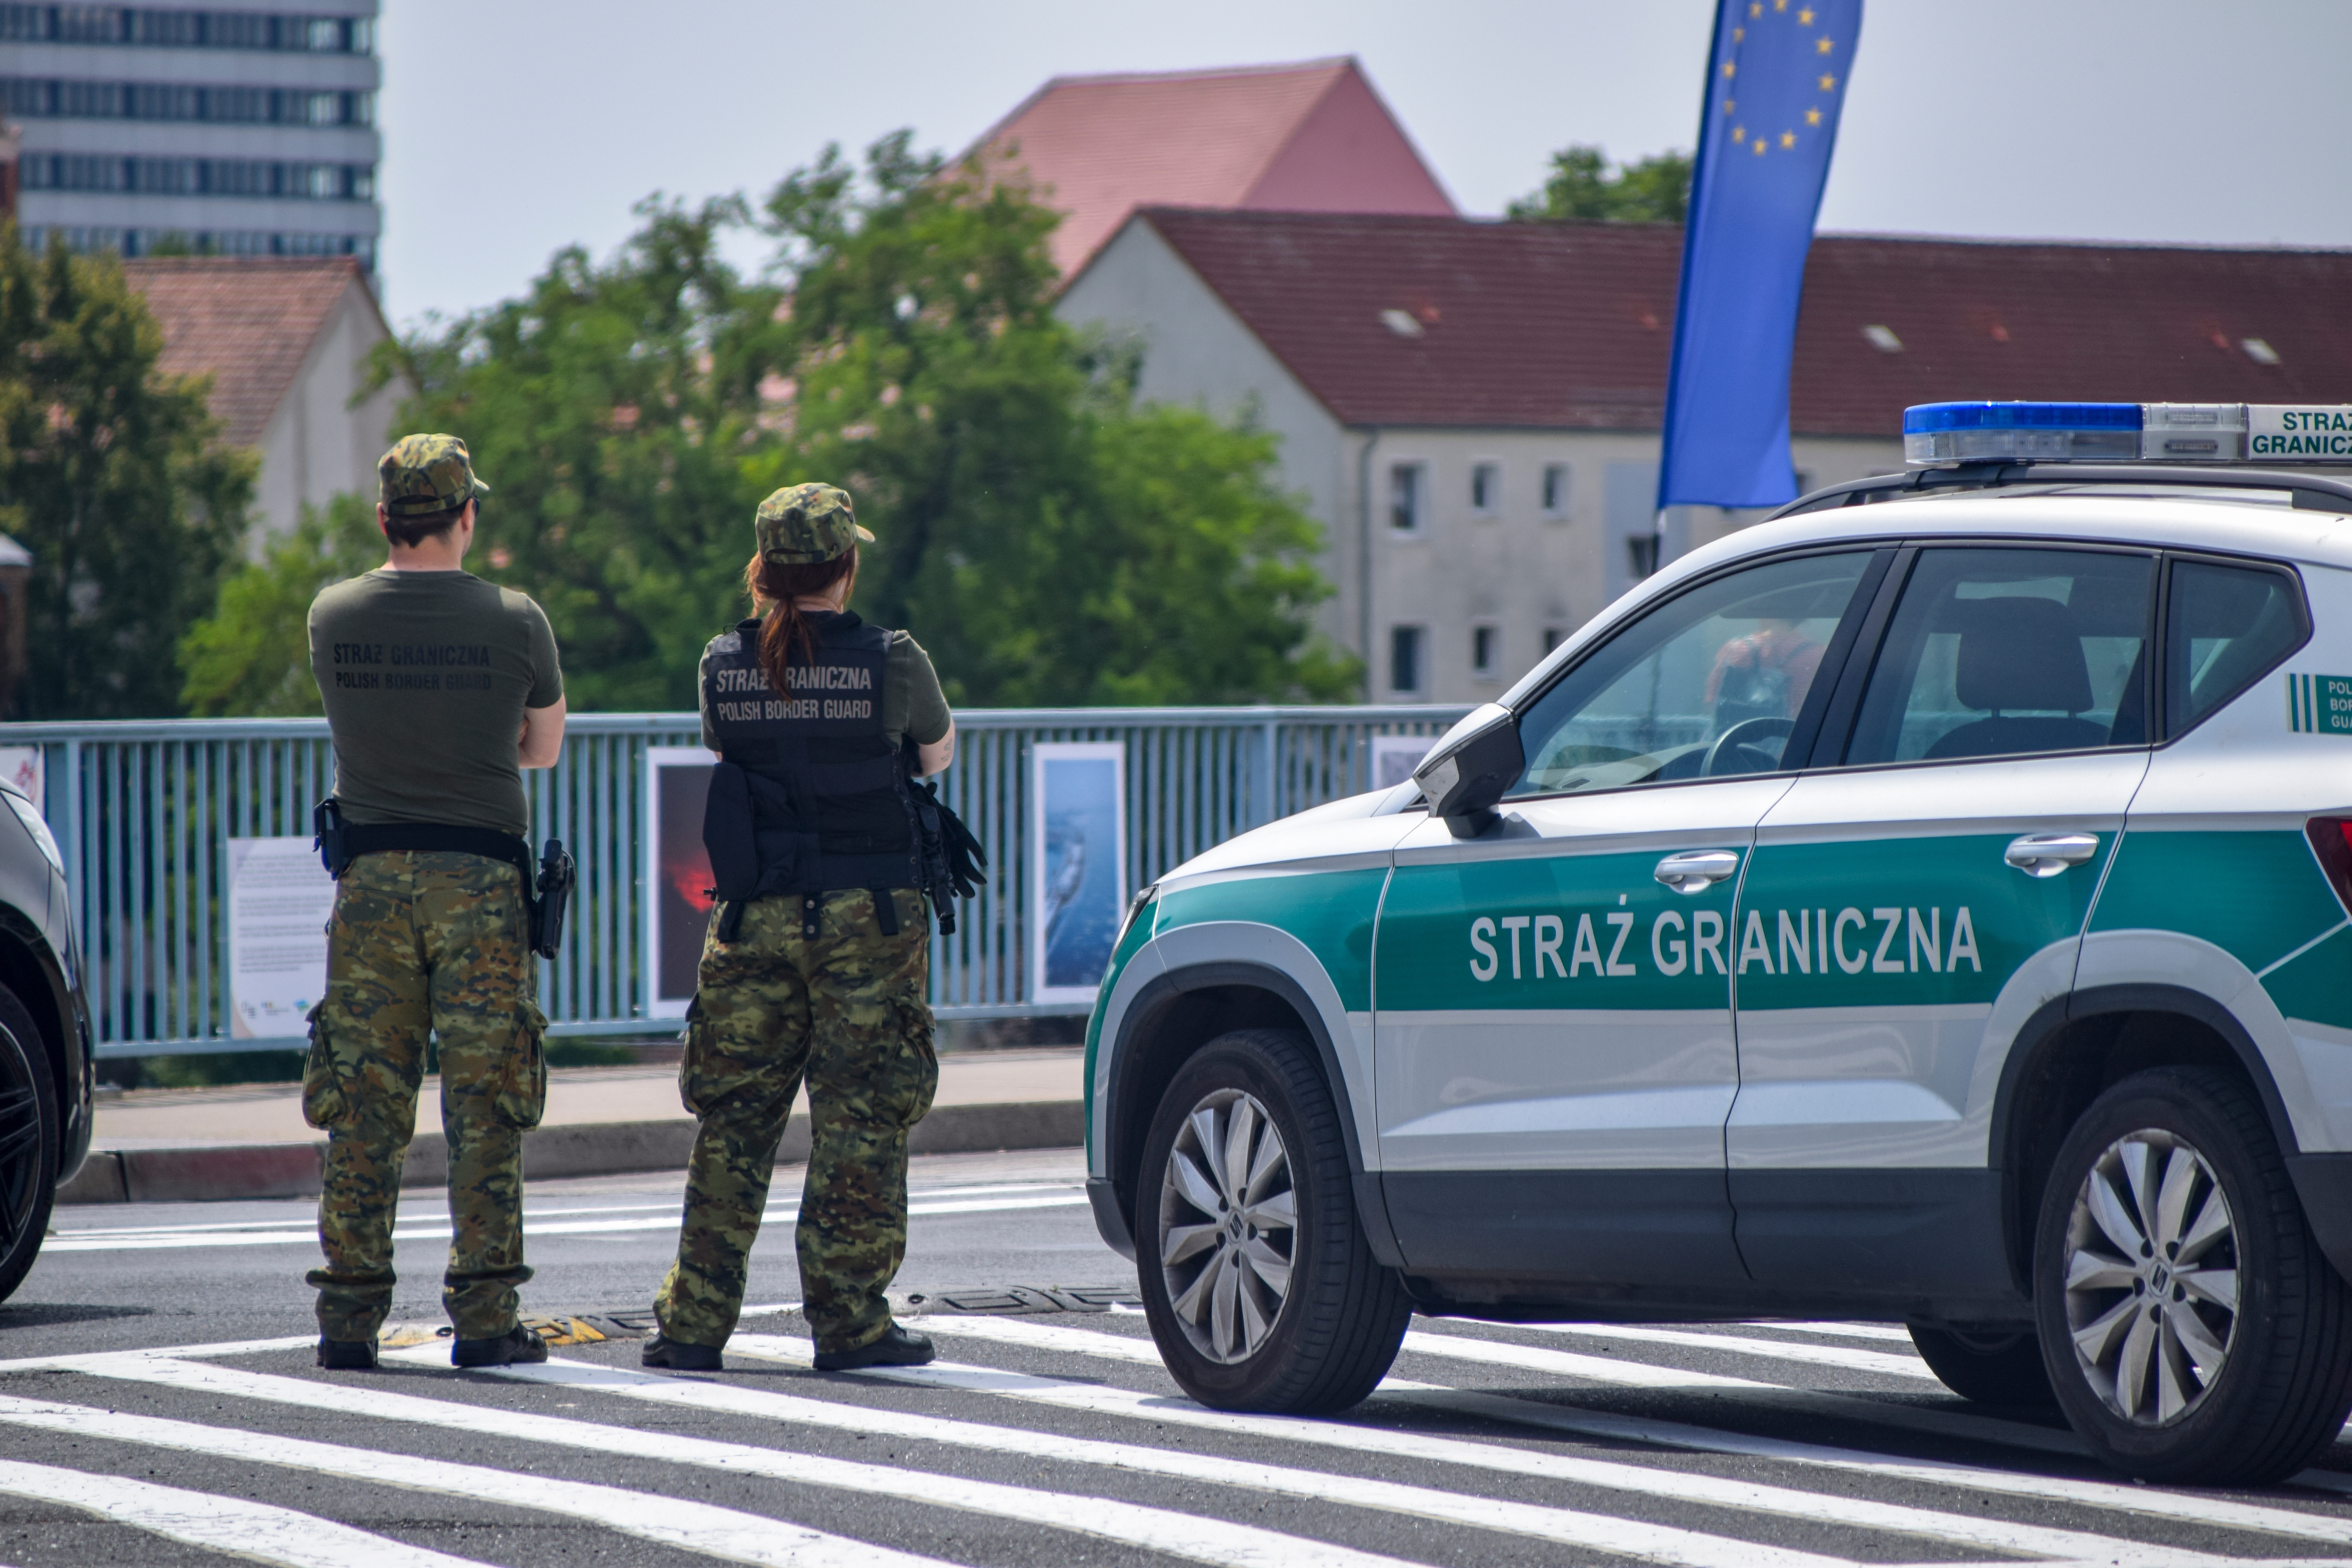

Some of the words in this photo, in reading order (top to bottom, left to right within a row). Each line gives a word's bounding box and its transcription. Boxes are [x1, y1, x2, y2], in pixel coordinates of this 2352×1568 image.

[391, 644, 490, 665] GRANICZNA
[336, 671, 378, 689] POLISH
[385, 673, 439, 690] BORDER
[445, 673, 491, 691] GUARD
[784, 666, 872, 690] RANICZNA
[717, 701, 761, 721] POLISH
[765, 699, 819, 719] BORDER
[824, 700, 872, 719] GUARD
[2331, 715, 2352, 728] GU
[1470, 894, 1636, 982] STRAŻ
[1651, 906, 1982, 977] GRANICZNA
